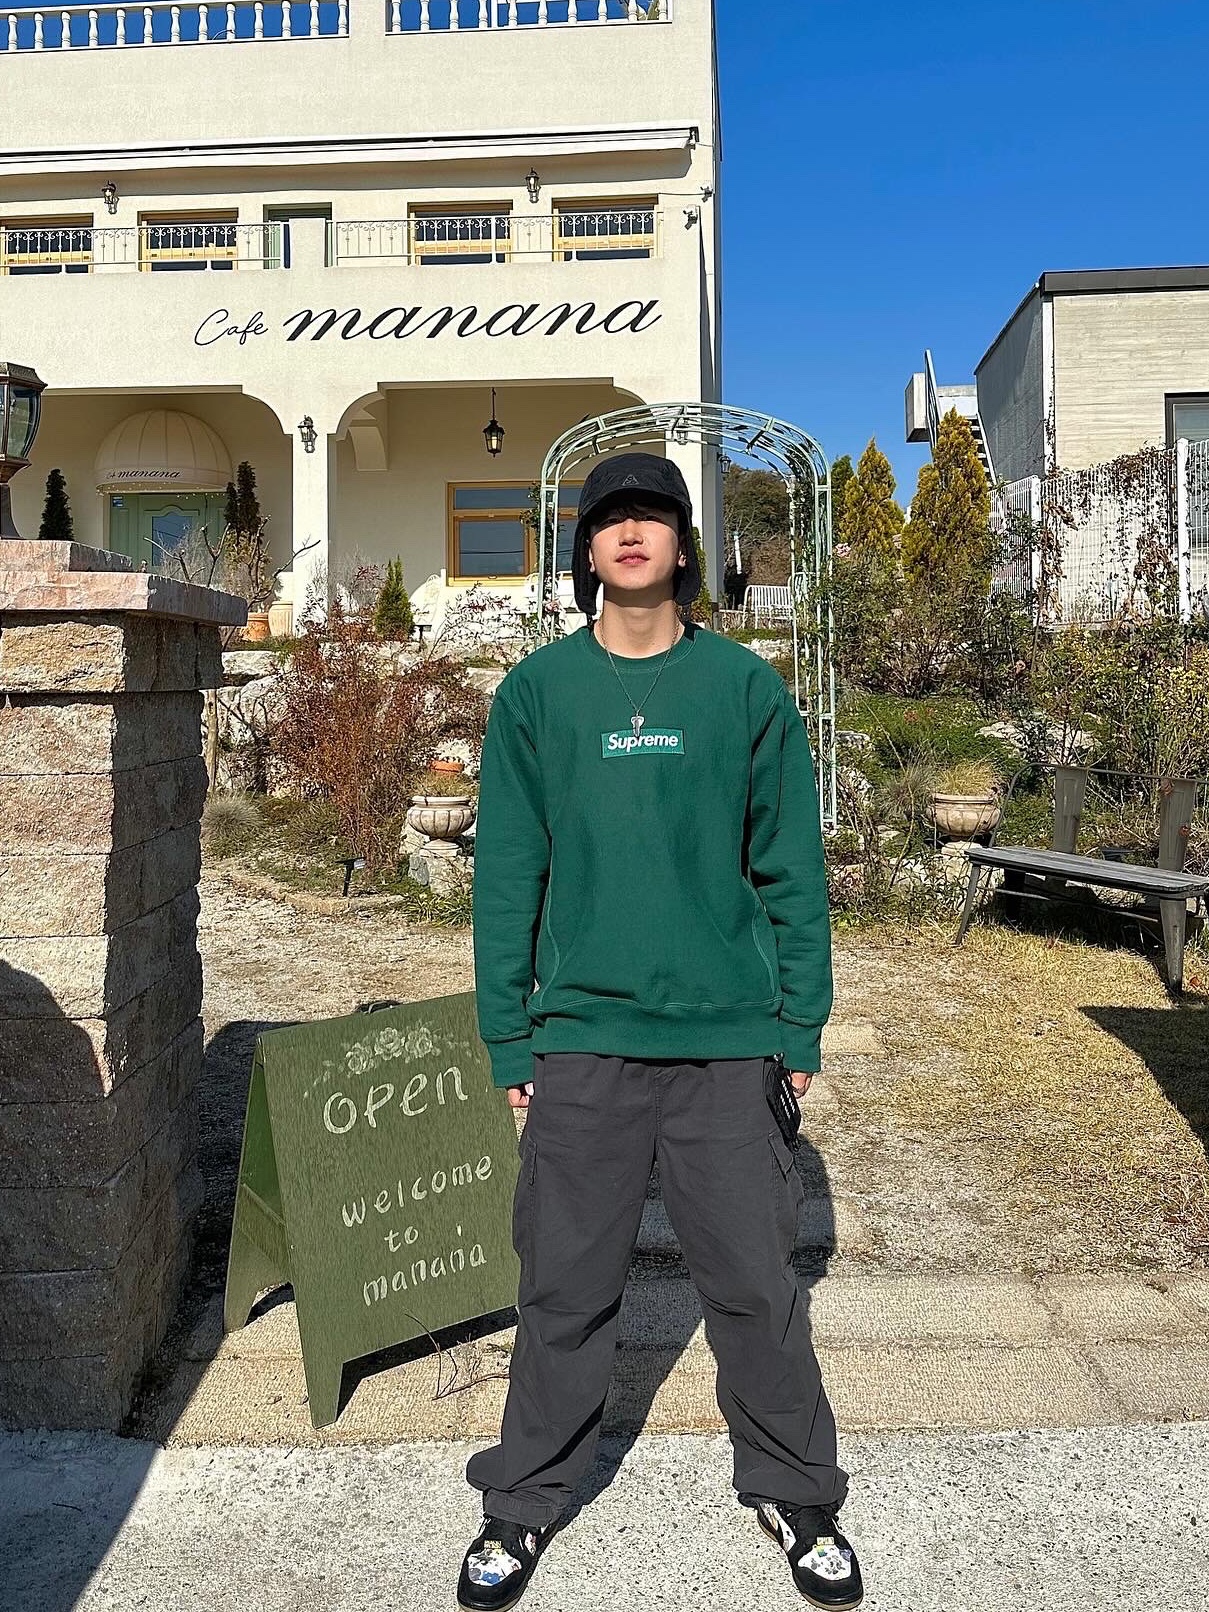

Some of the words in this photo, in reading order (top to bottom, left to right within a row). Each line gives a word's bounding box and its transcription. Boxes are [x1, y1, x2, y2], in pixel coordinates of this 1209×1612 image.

[194, 309, 269, 346] Cafe
[283, 299, 662, 342] manana
[117, 470, 181, 478] manana
[607, 733, 679, 753] Supreme
[342, 1155, 493, 1228] welcome
[384, 1226, 419, 1253] to
